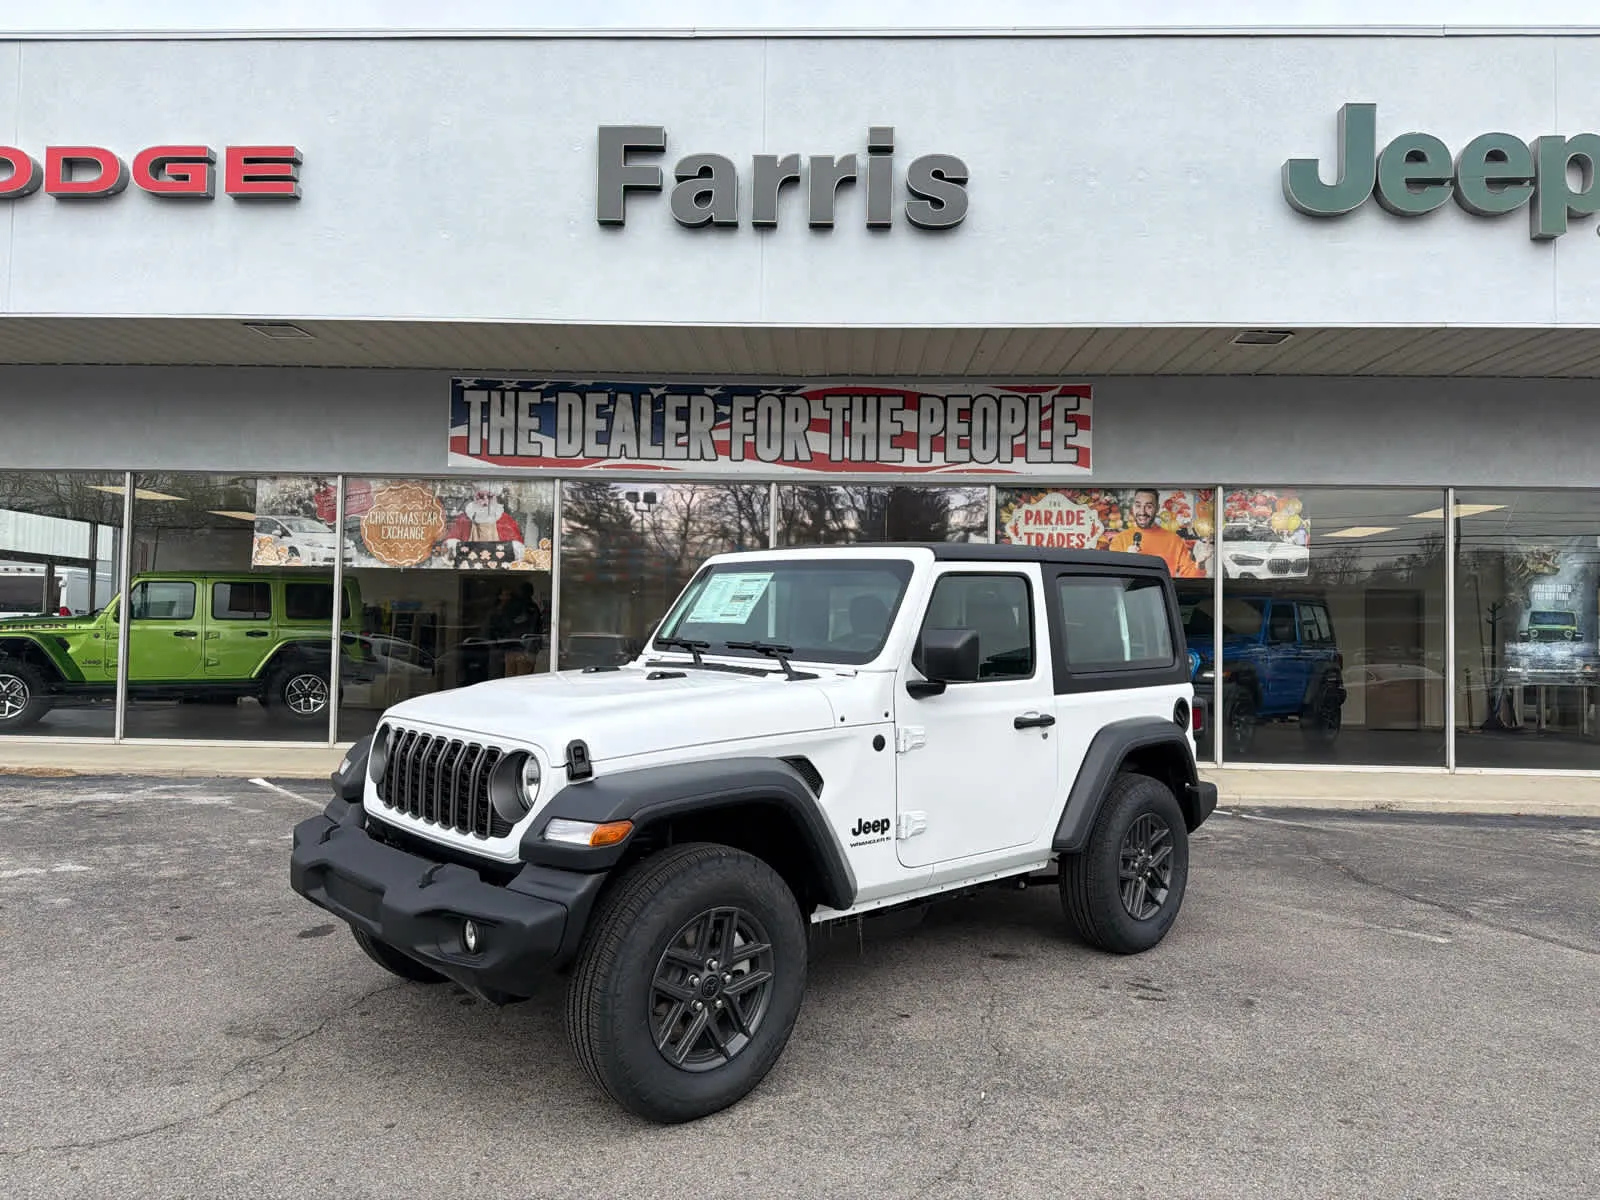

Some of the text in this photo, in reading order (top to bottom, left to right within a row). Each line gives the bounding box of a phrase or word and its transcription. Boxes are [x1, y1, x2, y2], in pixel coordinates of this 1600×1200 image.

[597, 125, 970, 231] Farris
[1281, 102, 1600, 239] Jeep
[463, 388, 1080, 465] THE DEALER FOR THE PEOPLE
[369, 511, 438, 525] CHRISTMAS CAR
[1024, 509, 1086, 526] PARADE
[381, 526, 425, 540] EXCHANGE
[1024, 533, 1086, 549] TRADES
[851, 818, 890, 836] Jeep
